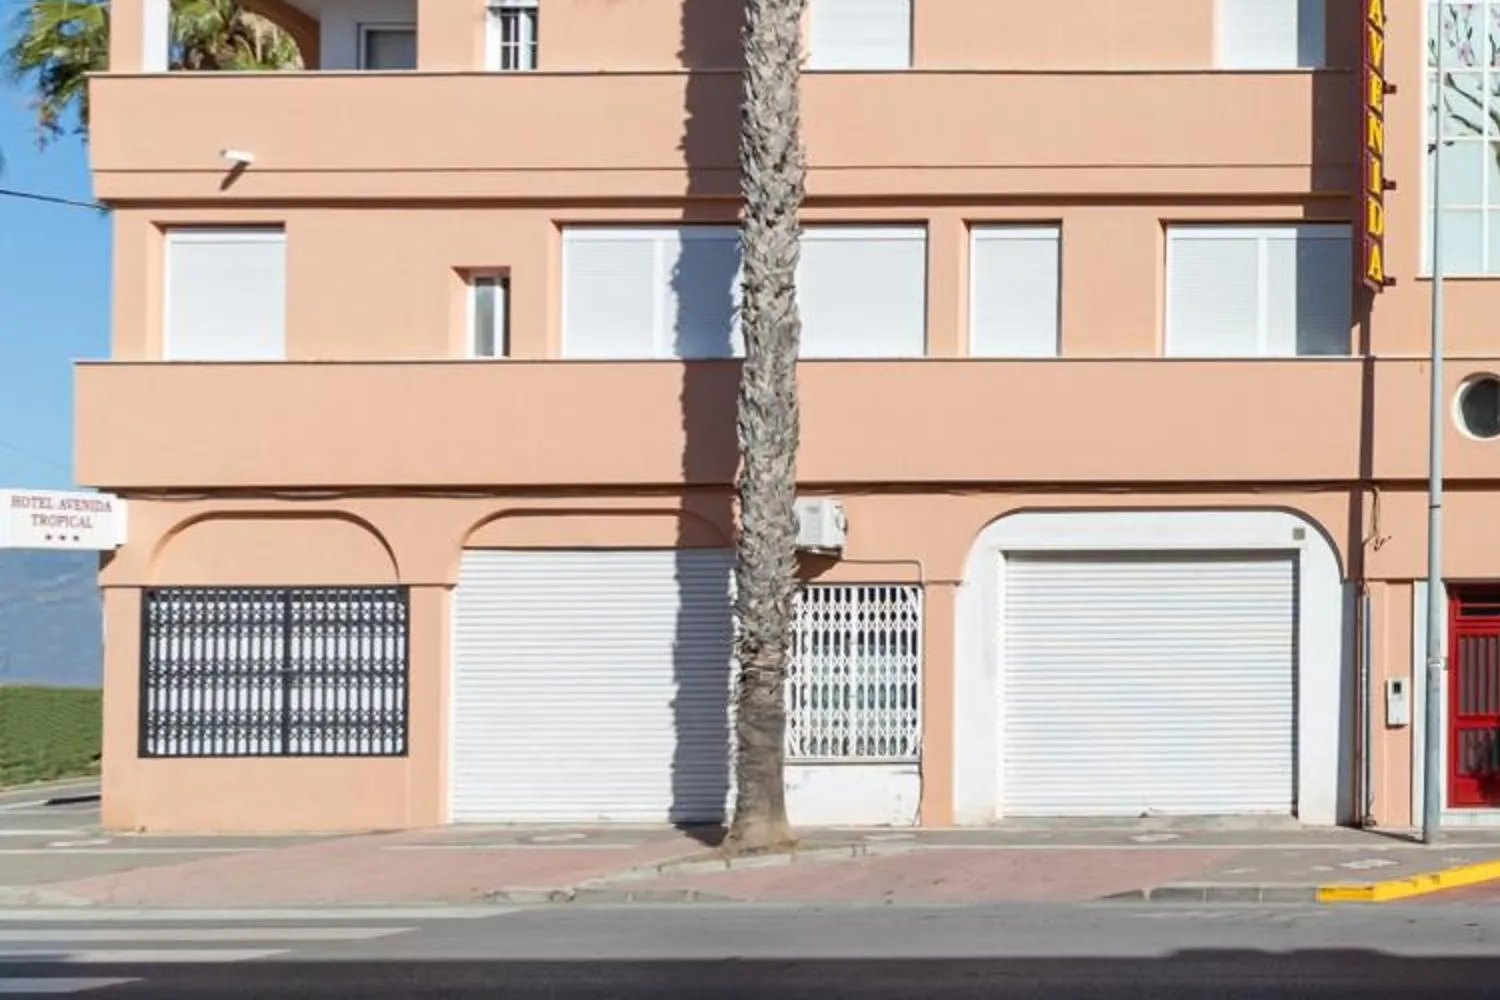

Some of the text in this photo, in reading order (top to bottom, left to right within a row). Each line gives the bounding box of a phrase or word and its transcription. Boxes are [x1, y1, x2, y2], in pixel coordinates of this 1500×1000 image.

[11, 495, 112, 512] HOTEL AVENIDA
[31, 513, 93, 528] TROPICAL
